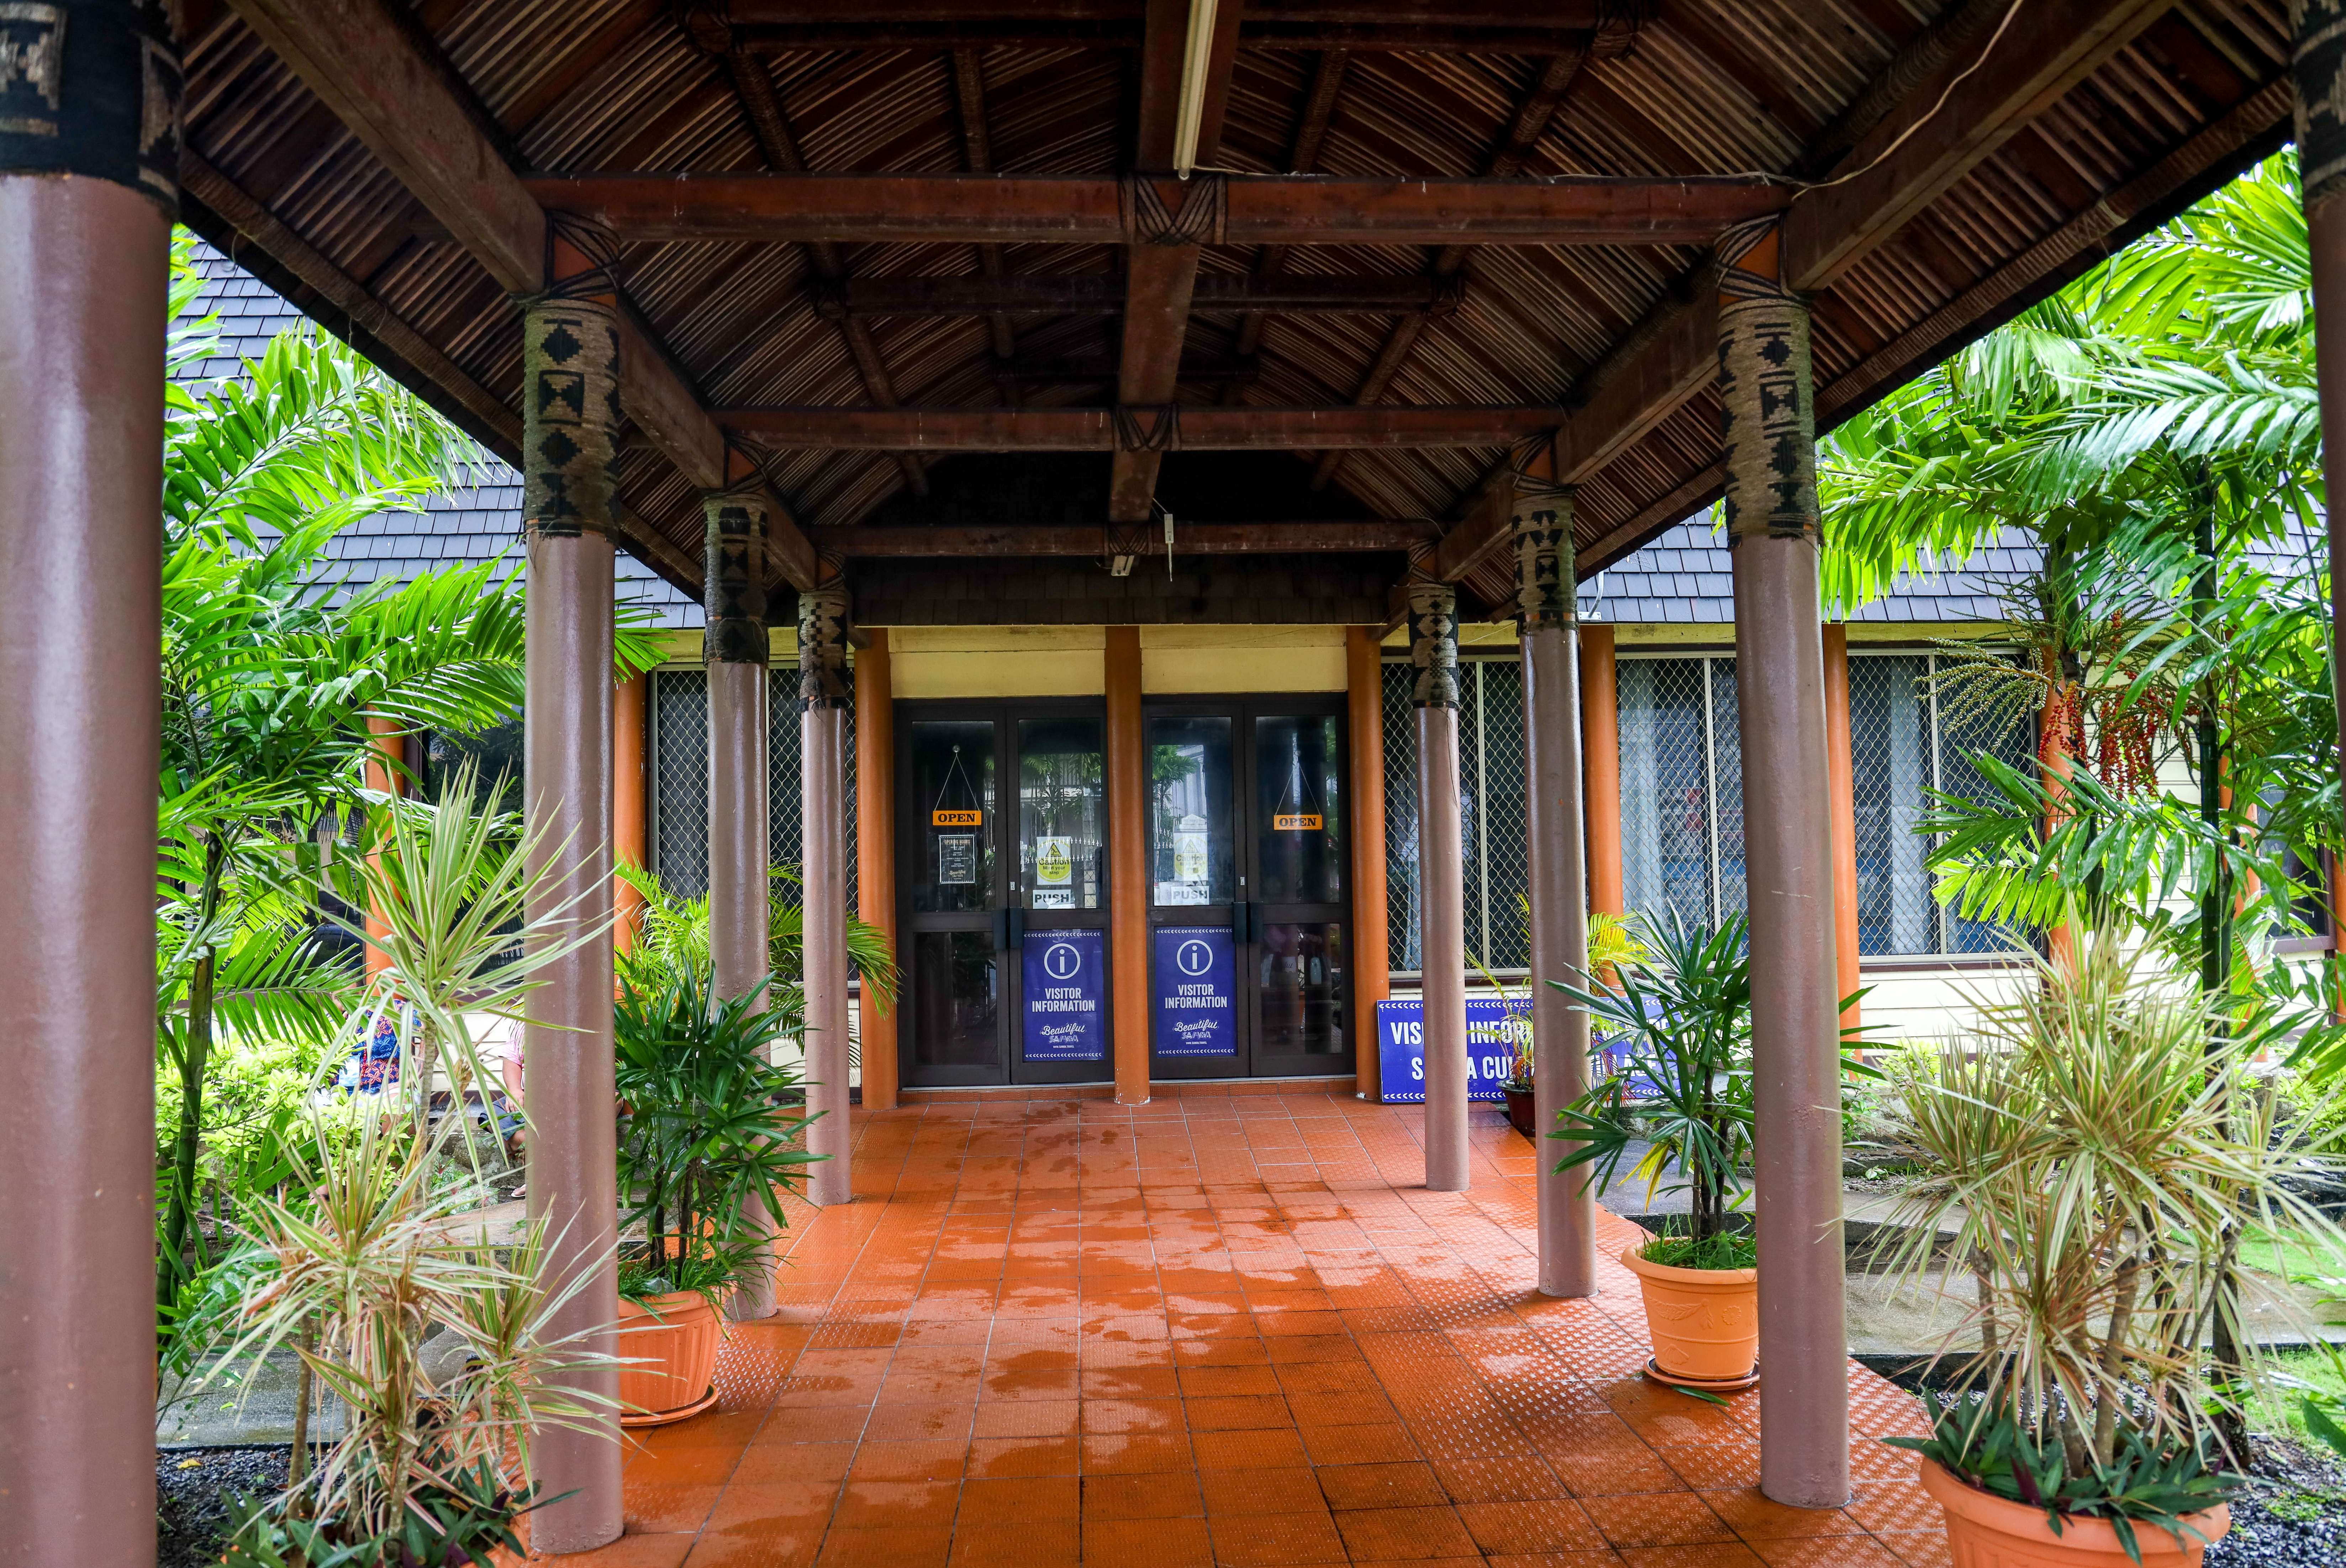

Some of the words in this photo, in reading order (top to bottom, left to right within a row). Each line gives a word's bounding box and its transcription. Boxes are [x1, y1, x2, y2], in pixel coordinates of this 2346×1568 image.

[938, 814, 975, 822] OPEN
[1279, 818, 1317, 827] OPEN
[1035, 894, 1069, 903] PUSH
[1173, 891, 1208, 899] PUSH
[1045, 988, 1082, 999] VISITOR
[1177, 984, 1214, 996] VISITOR
[1032, 1000, 1095, 1012] INFORMATION
[1165, 997, 1227, 1009] INFORMATION
[1041, 1023, 1085, 1036] Beautiful
[1174, 1019, 1218, 1032] Beautiful
